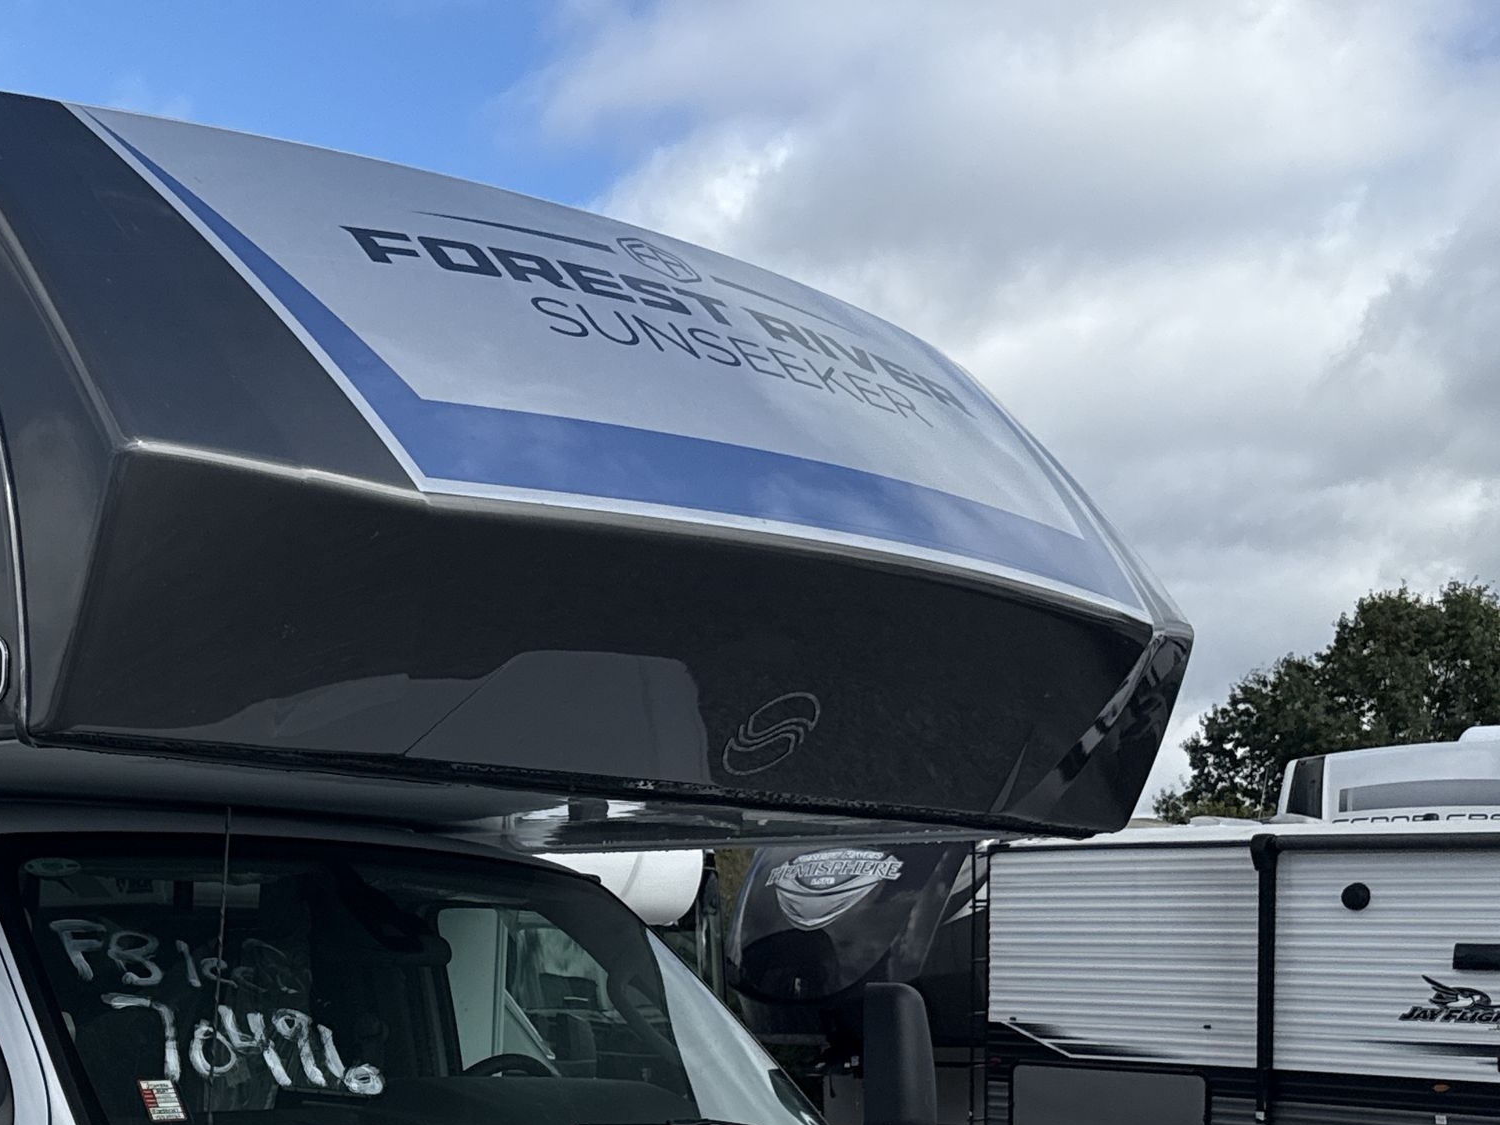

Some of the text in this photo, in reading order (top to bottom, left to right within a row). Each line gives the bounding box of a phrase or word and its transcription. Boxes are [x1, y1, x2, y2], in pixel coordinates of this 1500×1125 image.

[338, 224, 980, 421] FOREST RIVER
[529, 296, 934, 428] SUNSEEKER
[765, 857, 904, 886] HEMISPHERE
[1398, 1005, 1441, 1022] JAY
